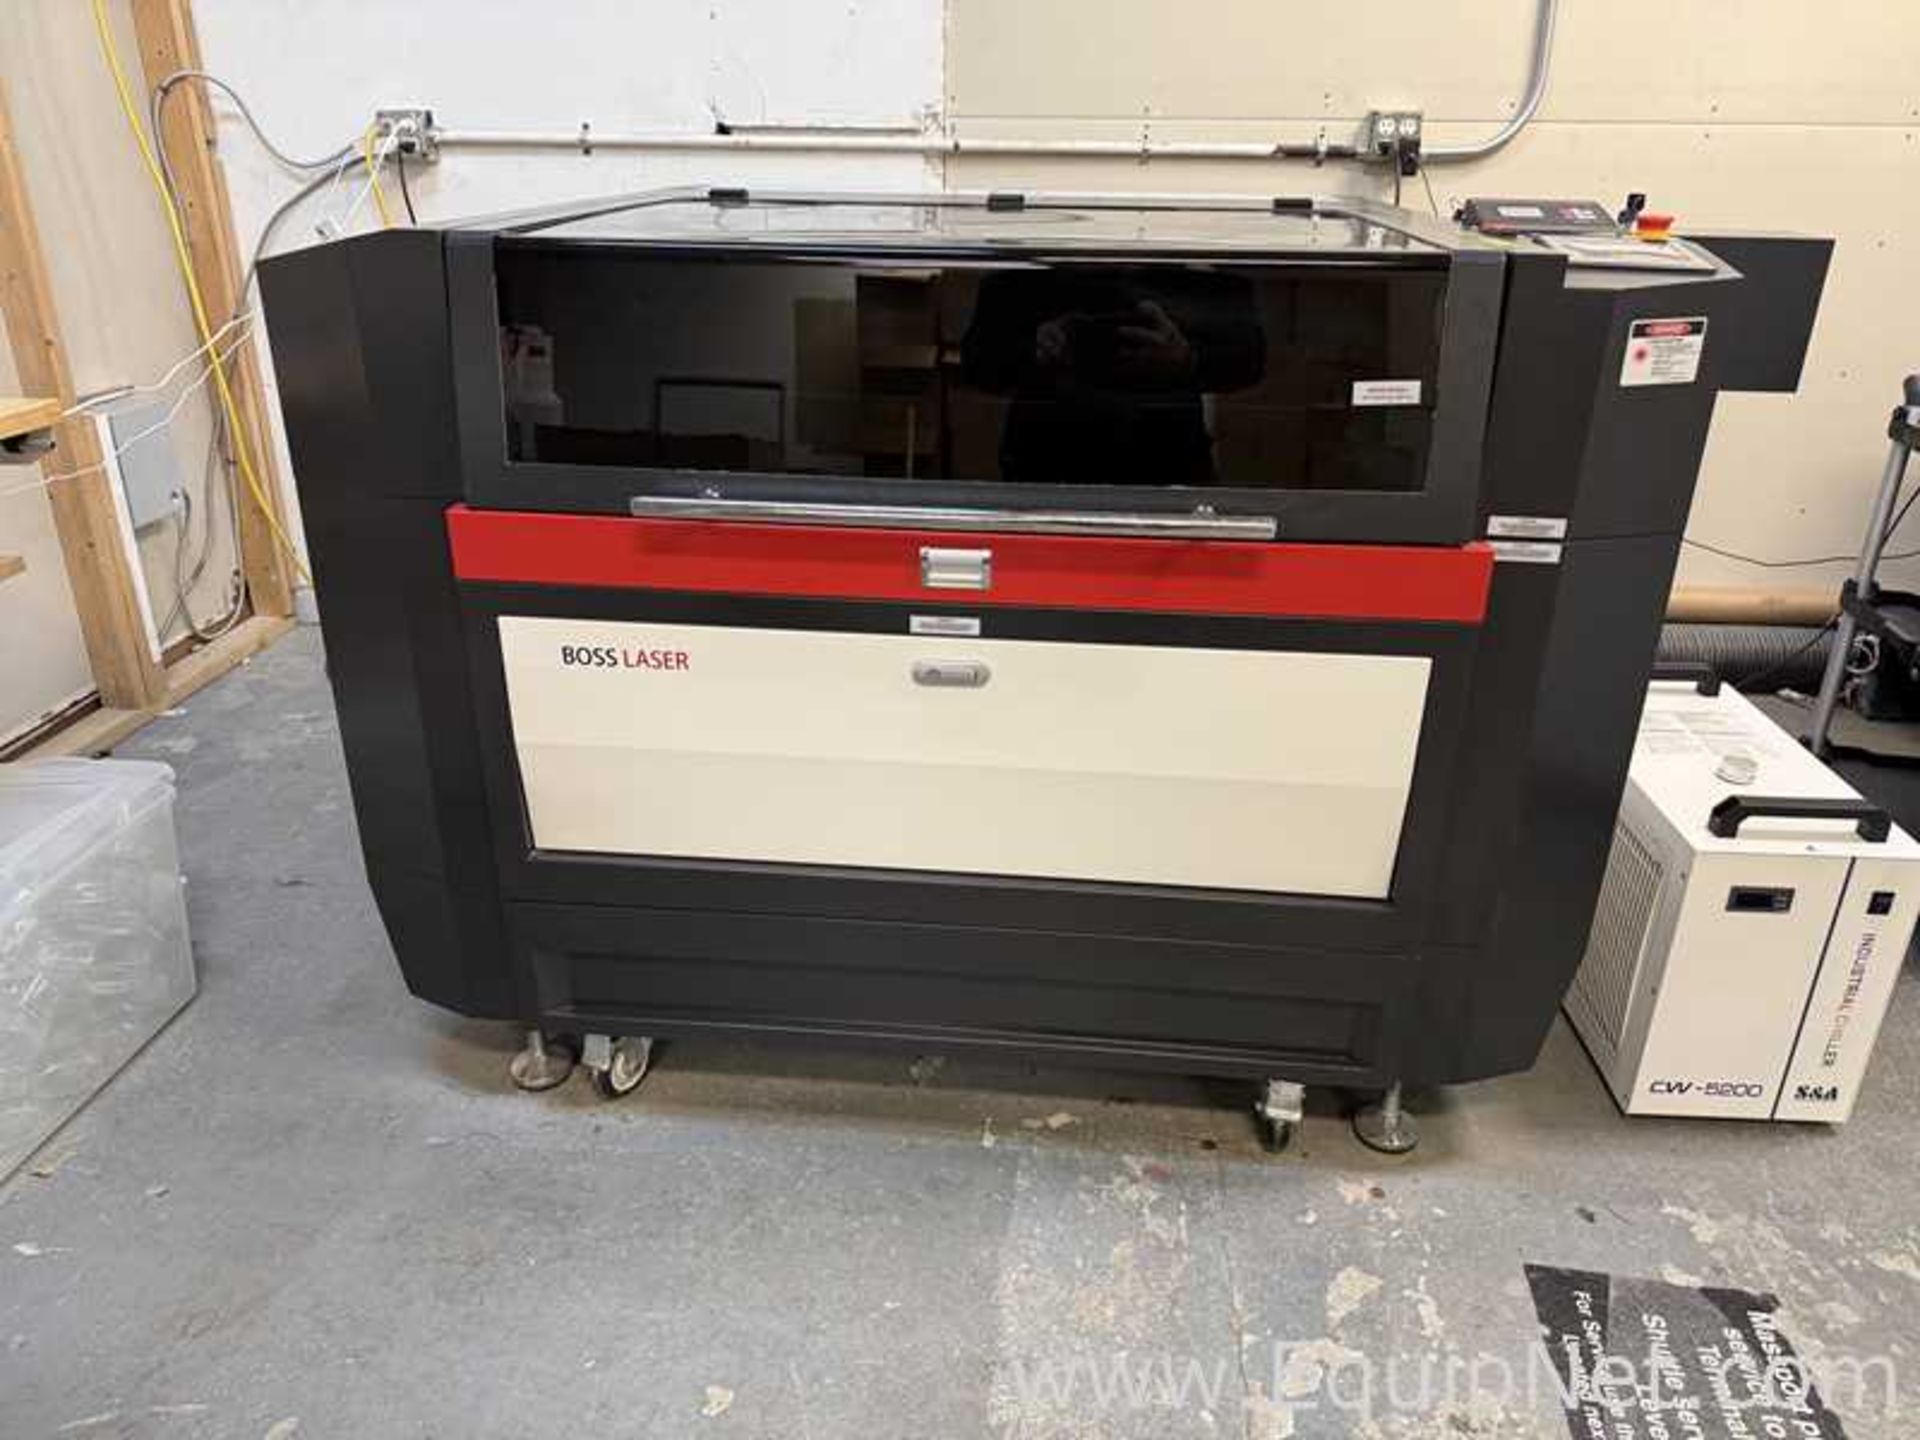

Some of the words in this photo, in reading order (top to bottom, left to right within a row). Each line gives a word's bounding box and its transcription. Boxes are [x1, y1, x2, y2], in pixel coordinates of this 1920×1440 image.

[561, 645, 618, 667] BOSS
[622, 648, 690, 671] LASER
[1839, 932, 1877, 1011] INDUSTRIAL
[1573, 1290, 1593, 1317] For
[1562, 1334, 1593, 1400] Lated
[1641, 1313, 1687, 1391] Shuttle
[1761, 1414, 1787, 1439] to
